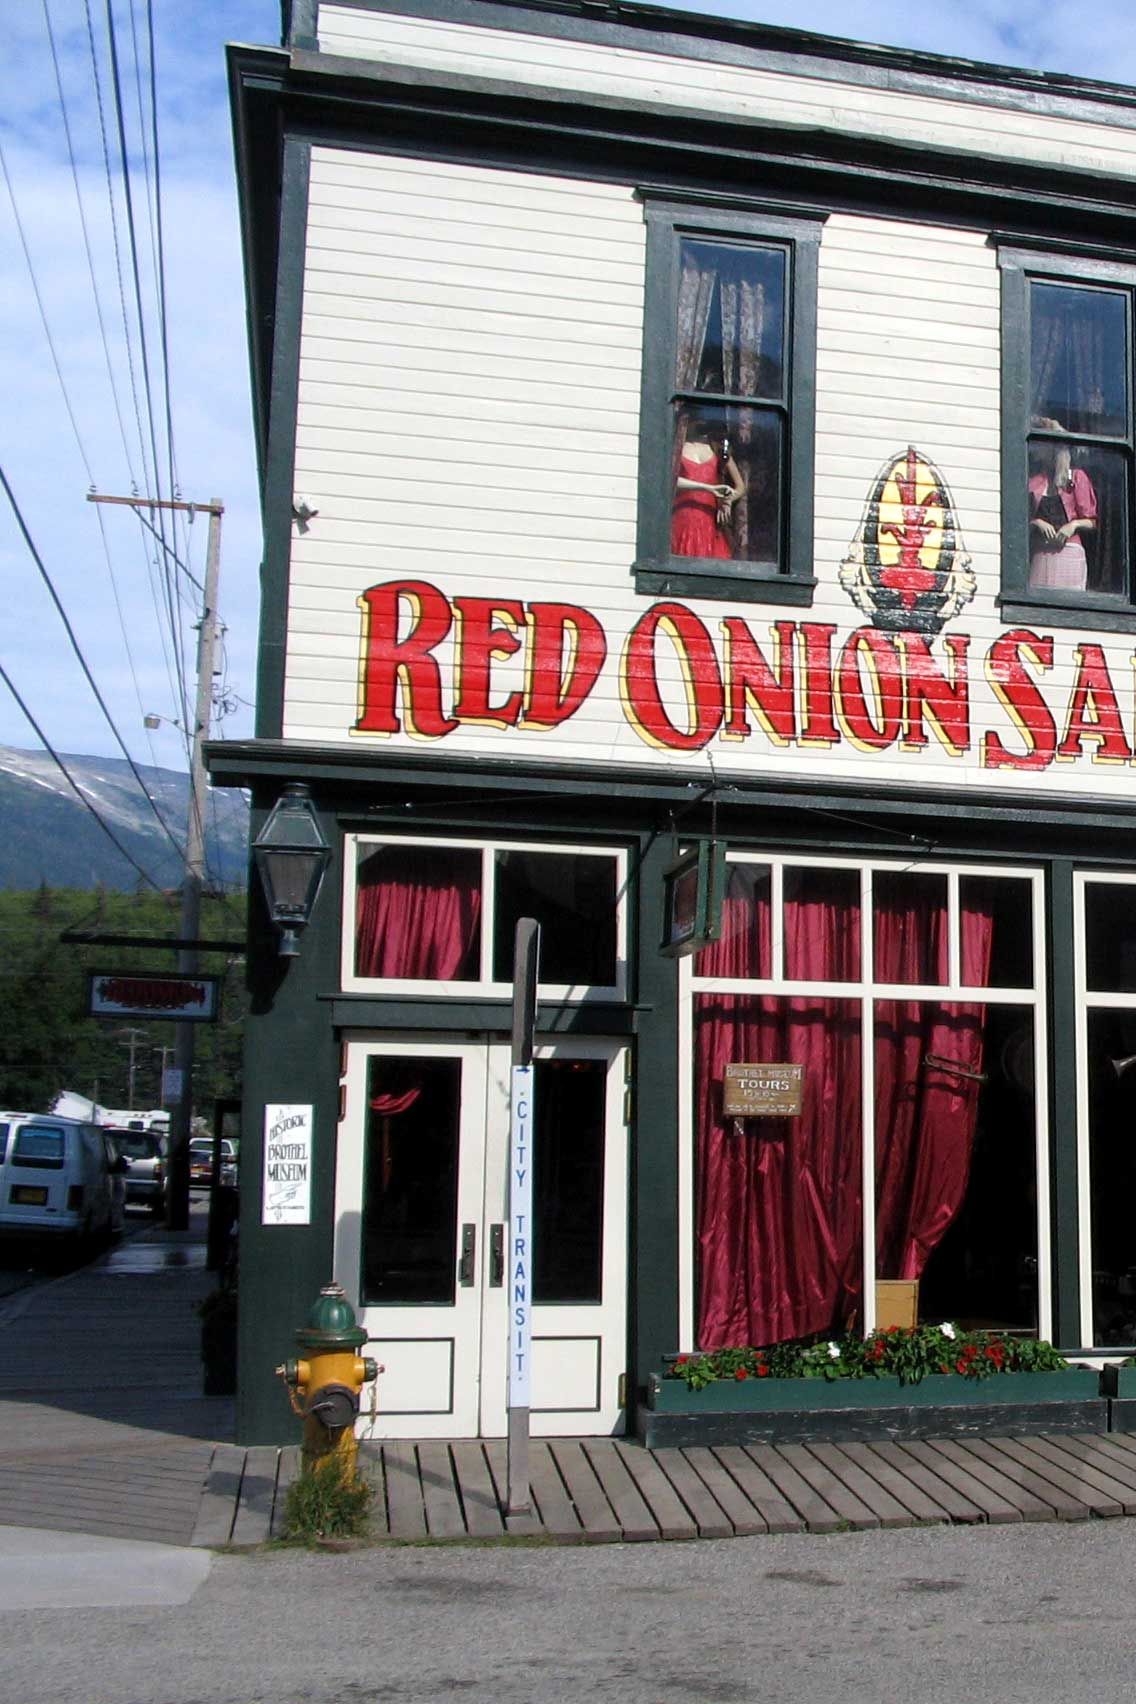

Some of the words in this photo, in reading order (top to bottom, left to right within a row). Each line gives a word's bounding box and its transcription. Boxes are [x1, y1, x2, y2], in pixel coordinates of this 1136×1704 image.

[349, 579, 607, 742] RED
[619, 601, 972, 756] ONION
[737, 1079, 790, 1091] TOURS
[268, 1113, 307, 1142] HISTORIC
[268, 1143, 308, 1160] BROTHEL
[516, 1100, 528, 1188] CITY
[267, 1163, 307, 1181] MUSEUM
[514, 1214, 527, 1373] TRANSIT
